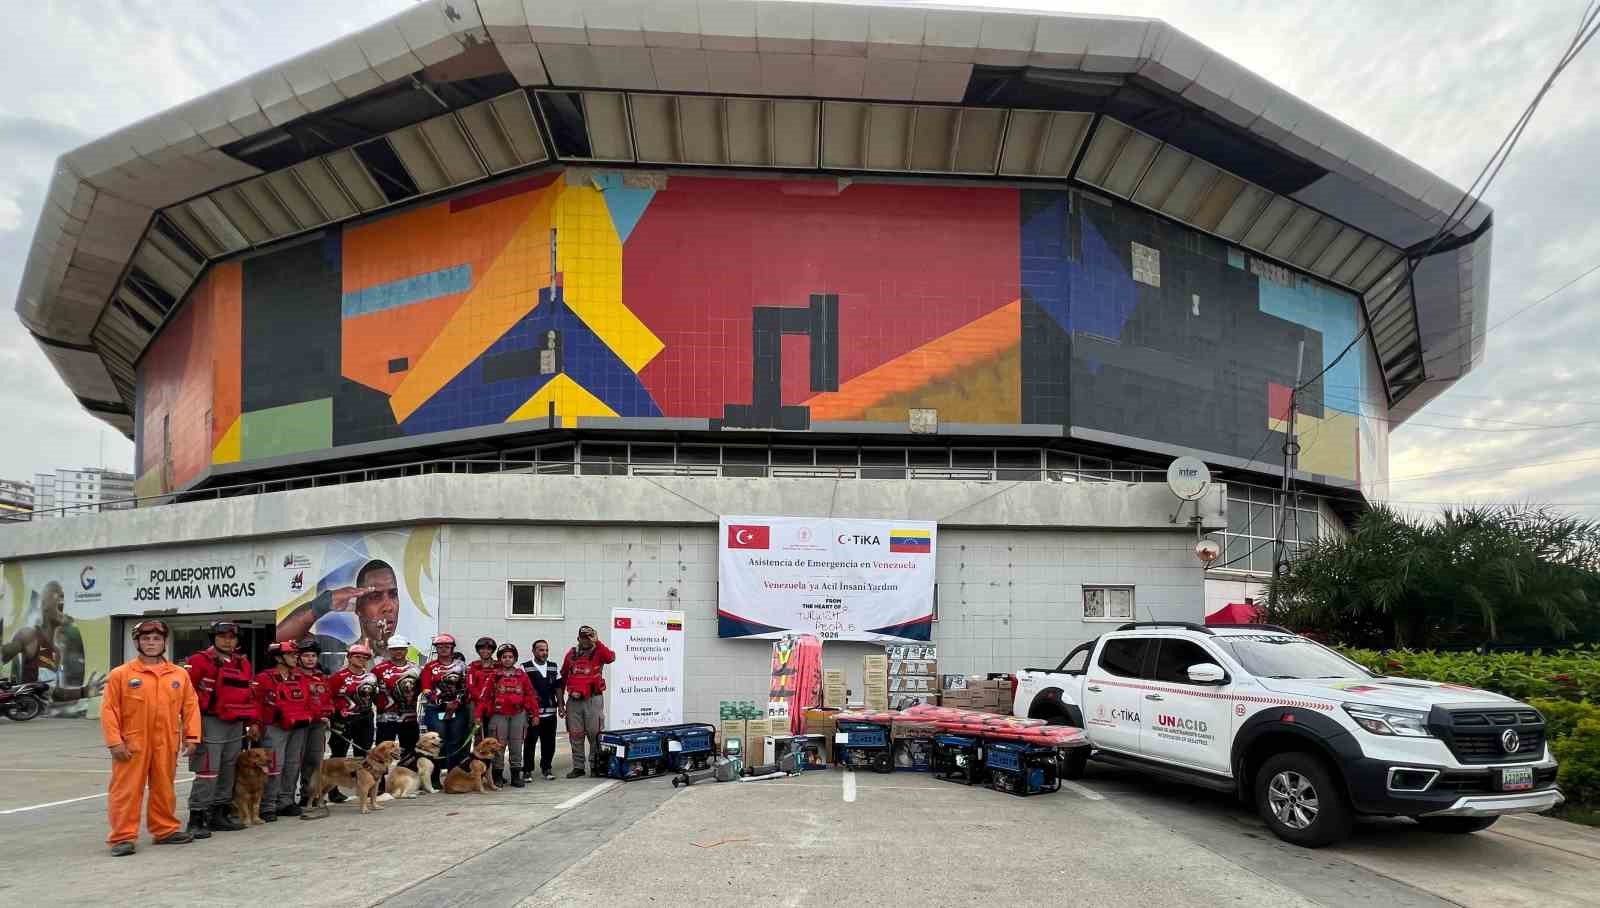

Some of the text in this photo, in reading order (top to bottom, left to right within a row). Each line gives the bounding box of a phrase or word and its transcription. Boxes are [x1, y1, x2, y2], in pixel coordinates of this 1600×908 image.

[749, 558, 793, 567] Asistencia
[795, 559, 805, 567] de
[807, 560, 858, 569] Emergencia
[872, 561, 917, 569] Venezuela
[150, 565, 236, 583] POLIDEPORTIVO
[133, 580, 161, 601] JOSÉ
[165, 579, 201, 600] MARÍA
[207, 582, 256, 598] VARGAS
[821, 581, 838, 590] Acil
[1158, 714, 1208, 732] UNACID
